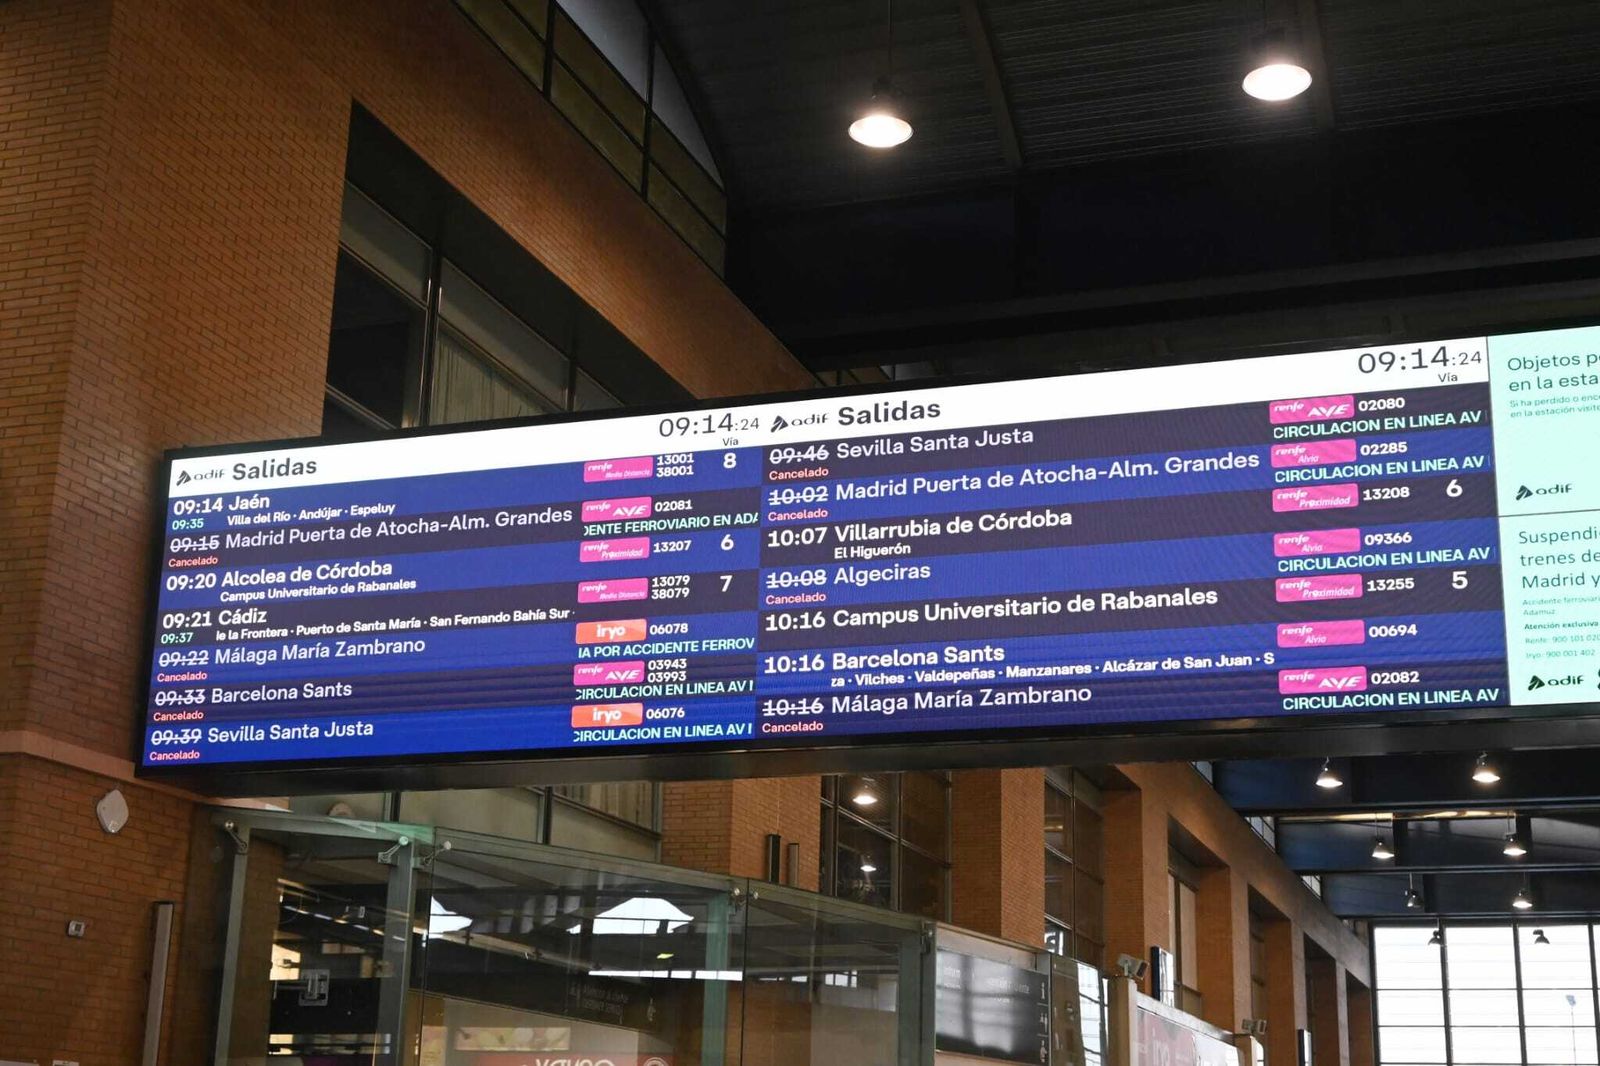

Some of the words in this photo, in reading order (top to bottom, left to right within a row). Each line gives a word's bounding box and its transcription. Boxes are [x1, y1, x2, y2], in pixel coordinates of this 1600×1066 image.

[1508, 355, 1580, 372] Objetos
[1438, 372, 1458, 383] Vía
[1538, 377, 1552, 389] la
[1307, 403, 1351, 417] AVE
[1359, 397, 1405, 412] 02080
[791, 413, 829, 426] adif
[838, 401, 941, 426] Salidas
[1274, 419, 1381, 439] CIRCULACION
[1384, 417, 1405, 430] EN
[1409, 412, 1456, 429] LINEA
[1459, 410, 1482, 424] AV
[723, 436, 739, 447] Vía
[770, 445, 829, 464] 09:46
[837, 440, 904, 459] Sevilla
[910, 435, 969, 453] Santa
[975, 428, 1033, 447] Justa
[1360, 441, 1408, 456] 02285
[657, 453, 694, 465] 13001
[723, 453, 736, 468] 8
[194, 469, 225, 480] adif
[232, 458, 317, 480] Salidas
[656, 466, 694, 477] 38001
[769, 467, 829, 480] Cancelado
[769, 487, 828, 505] 10:02
[836, 480, 907, 500] Madrid
[914, 474, 981, 494] Puerta
[988, 469, 1014, 487] de
[1165, 452, 1260, 474] Grandes
[1363, 486, 1410, 500] 13208
[1446, 479, 1462, 498] 6
[1536, 483, 1572, 495] adif
[174, 498, 222, 515] 09:14
[229, 495, 270, 510] Jaén
[613, 505, 649, 516] AVE
[655, 499, 693, 512] 02081
[227, 514, 254, 525] Villa
[254, 514, 271, 524] del
[274, 511, 290, 522] Río
[300, 508, 342, 521] Andújar
[351, 503, 395, 516] Espeluy
[171, 535, 219, 552] 09:15
[226, 531, 284, 548] Madrid
[290, 527, 345, 544] Puerta
[350, 525, 371, 539] de
[495, 508, 572, 527] Grandes
[172, 519, 204, 530] 09:35
[768, 528, 827, 547] 10:07
[834, 519, 941, 542] Villarrubia
[947, 518, 973, 534] de
[979, 510, 1072, 532] Córdoba
[721, 535, 734, 550] 6
[1365, 531, 1412, 546] 09366
[1519, 526, 1600, 544] Suspendi
[654, 541, 691, 552] 13207
[834, 547, 848, 559] El
[850, 543, 911, 560] Higuerón
[169, 556, 218, 567] Cancelado
[1520, 553, 1575, 566] trenes
[167, 573, 216, 590] 09:20
[221, 567, 286, 587] Alcolea
[291, 567, 312, 582] de
[316, 561, 392, 579] Córdoba
[652, 575, 690, 587] 13079
[766, 569, 827, 588] 10:08
[834, 564, 931, 587] Algeciras
[1452, 571, 1468, 590] 5
[1522, 572, 1585, 588] Madrid
[220, 591, 265, 603] Campus
[268, 585, 338, 598] Universitario
[341, 584, 355, 593] de
[358, 579, 416, 592] Rabanales
[720, 576, 732, 591] 7
[1367, 577, 1414, 592] 13255
[652, 588, 690, 599] 38079
[766, 611, 826, 631] 10:16
[833, 607, 919, 630] Campus
[925, 596, 1061, 621] Universitario
[1067, 594, 1095, 611] de
[1100, 588, 1218, 611] Rabanales
[163, 612, 211, 628] 09:21
[219, 609, 267, 625] Cádiz
[229, 630, 238, 640] la
[241, 627, 288, 639] Frontera
[297, 624, 334, 635] Puerto
[336, 623, 350, 633] de
[354, 621, 386, 632] Santa
[389, 617, 420, 629] María
[430, 614, 451, 626] San
[454, 611, 510, 625] Fernando
[513, 608, 547, 621] Bahía
[549, 608, 569, 620] Sur
[597, 625, 625, 639] iryo
[650, 623, 688, 635] 06078
[1369, 623, 1417, 639] 00694
[161, 632, 193, 644] 09:37
[159, 650, 208, 667] 09:22
[215, 649, 276, 666] Málaga
[282, 643, 330, 660] María
[335, 639, 425, 657] Zambrano
[579, 647, 591, 658] IA
[594, 645, 620, 657] POR
[624, 641, 699, 655] ACCIDENTE
[702, 637, 754, 651] FERROV
[649, 659, 687, 670] 03943
[764, 654, 825, 673] 10:16
[833, 649, 938, 670] Barcelona
[944, 645, 1004, 664] Sants
[605, 669, 641, 680] AVE
[648, 671, 686, 683] 03993
[855, 672, 904, 686] Vilches
[915, 668, 995, 683] Valdepeñas
[1006, 662, 1092, 678] Manzanares
[1103, 657, 1158, 674] Alcázar
[1161, 656, 1180, 669] de
[1184, 654, 1212, 669] San
[1215, 653, 1252, 668] Juan
[1318, 675, 1362, 689] AVE
[1371, 670, 1419, 685] 02082
[1548, 675, 1584, 686] adif
[155, 689, 205, 706] 09:33
[212, 684, 297, 703] Barcelona
[303, 682, 352, 698] Sants
[763, 697, 824, 716] 10:16
[832, 694, 908, 715] Málaga
[914, 690, 973, 710] María
[980, 685, 1092, 706] Zambrano
[154, 711, 204, 722] Cancelado
[593, 708, 622, 722] iryo
[646, 708, 685, 719] 06076
[151, 729, 201, 745] 09:39
[208, 724, 264, 742] Sevilla
[269, 721, 319, 739] Santa
[324, 721, 373, 738] Justa
